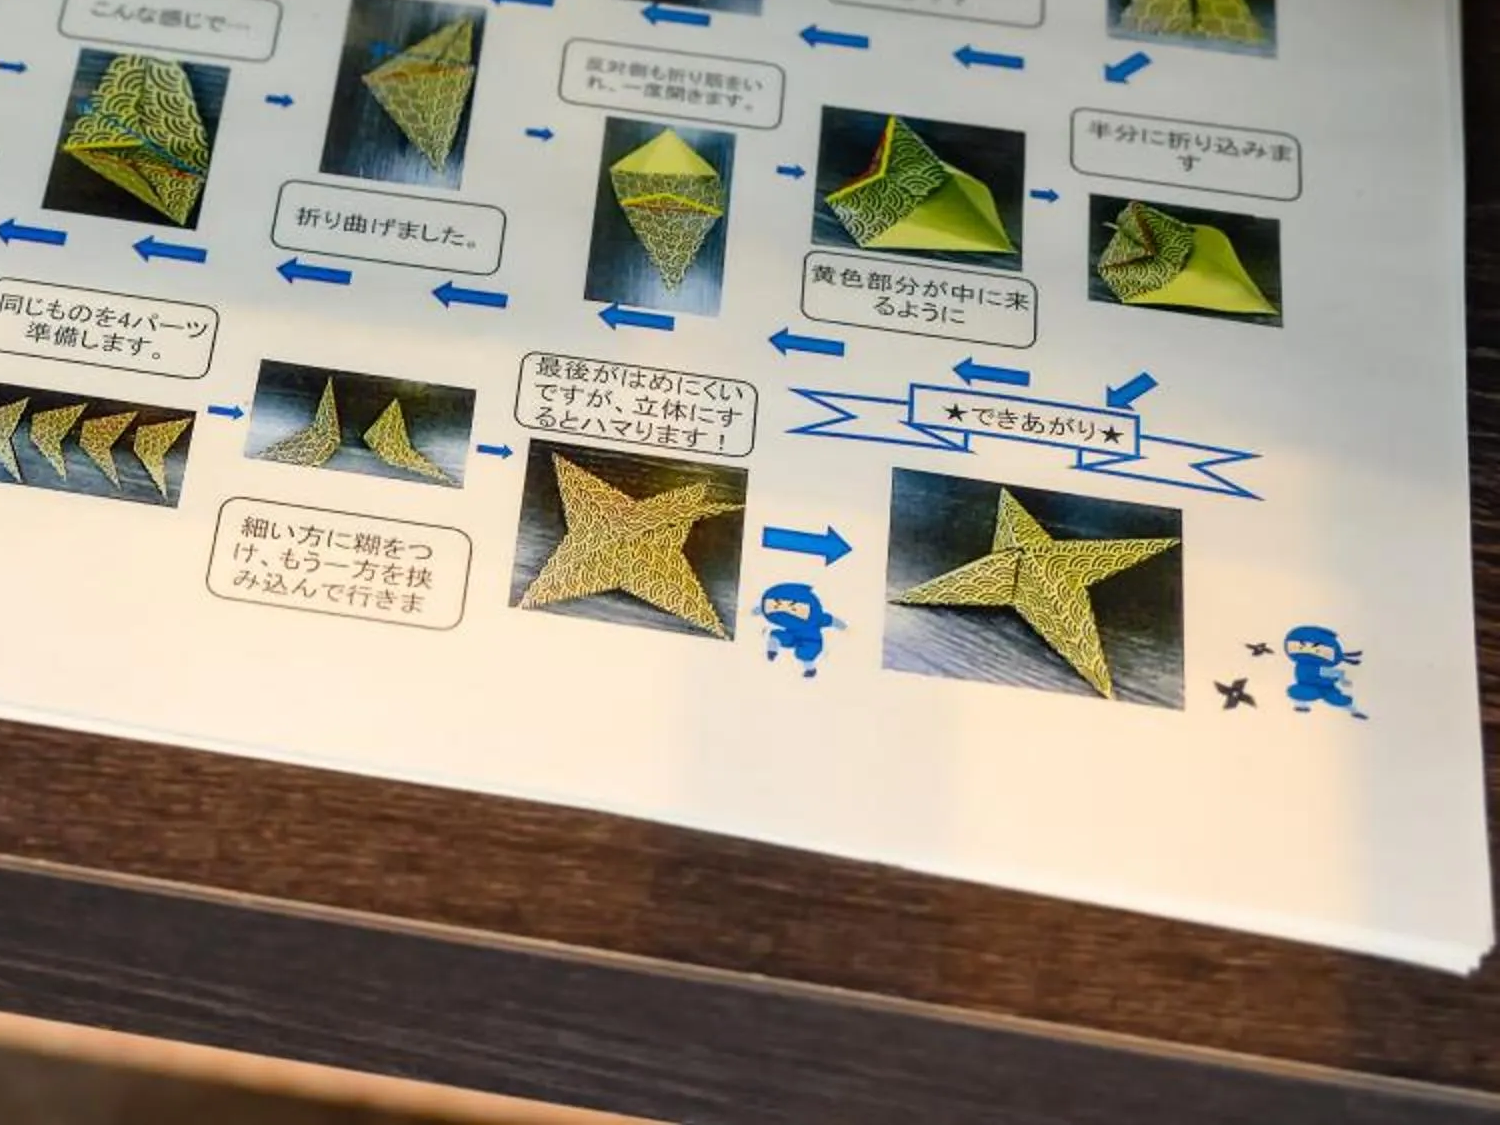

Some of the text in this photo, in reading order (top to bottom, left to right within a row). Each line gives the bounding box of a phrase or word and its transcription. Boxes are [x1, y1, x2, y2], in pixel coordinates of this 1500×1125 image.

[1088, 120, 1292, 162] 半分に折り込みま
[1177, 154, 1201, 172] す
[296, 207, 476, 249] 折り曲げました。
[811, 265, 1029, 311] 黄色部分が中に来
[873, 296, 965, 324] るように
[25, 322, 161, 360] 準備します。
[535, 356, 743, 400] 最後がはめにくい
[535, 382, 743, 427] ですが、立体にす
[535, 407, 725, 450] るとハマります！
[241, 516, 433, 561] 細い方に糊をつ
[233, 543, 433, 589] け、もう一方を挟
[233, 569, 425, 613] み込んで行きま
